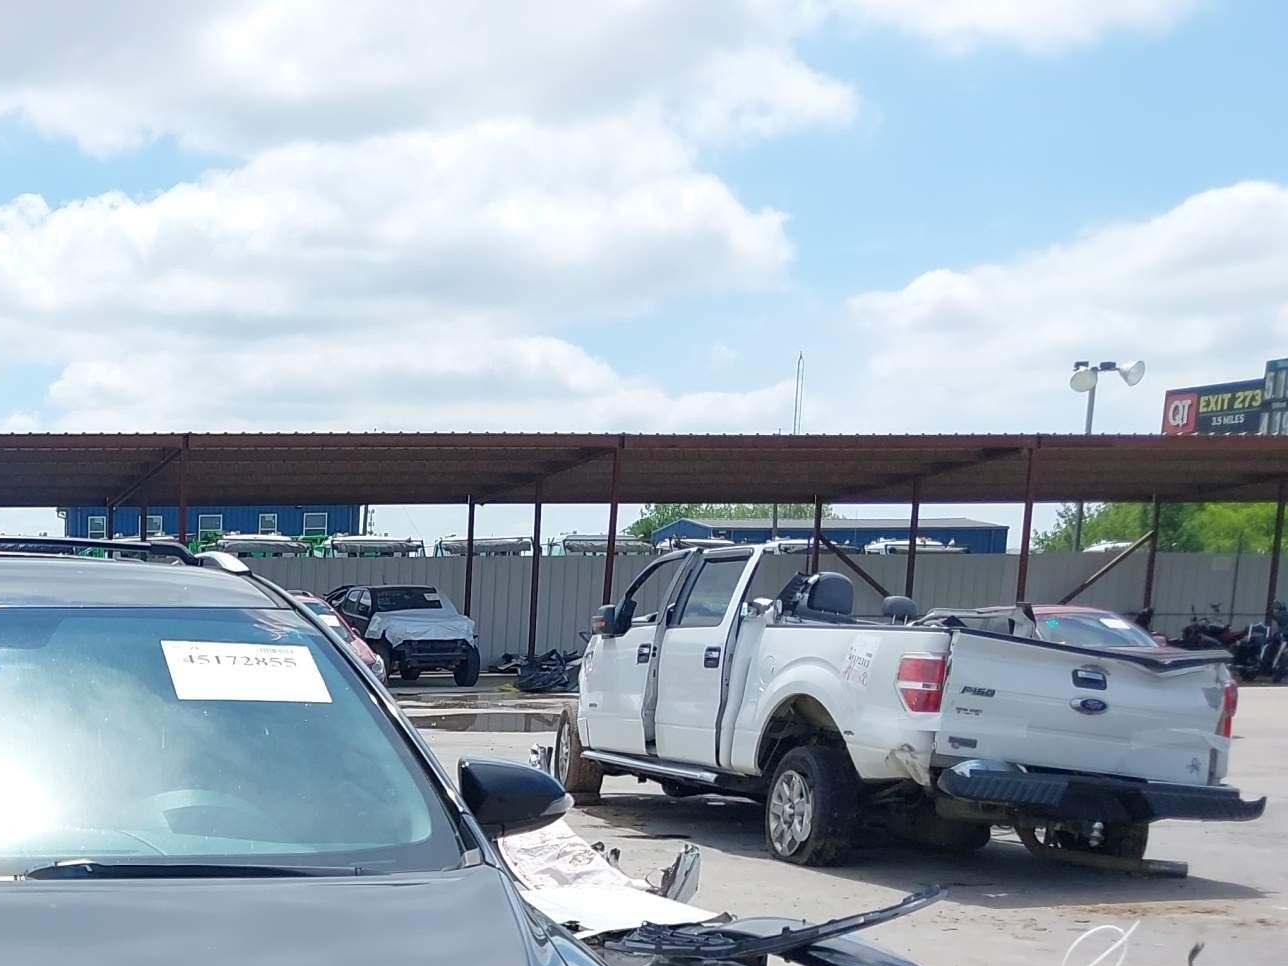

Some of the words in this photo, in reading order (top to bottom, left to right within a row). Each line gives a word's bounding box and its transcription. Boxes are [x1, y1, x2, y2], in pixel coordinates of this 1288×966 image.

[1199, 393, 1232, 412] EXIT
[1233, 389, 1262, 409] 273
[1169, 400, 1192, 428] QT
[1223, 414, 1245, 425] MILES
[183, 654, 297, 668] 45172855
